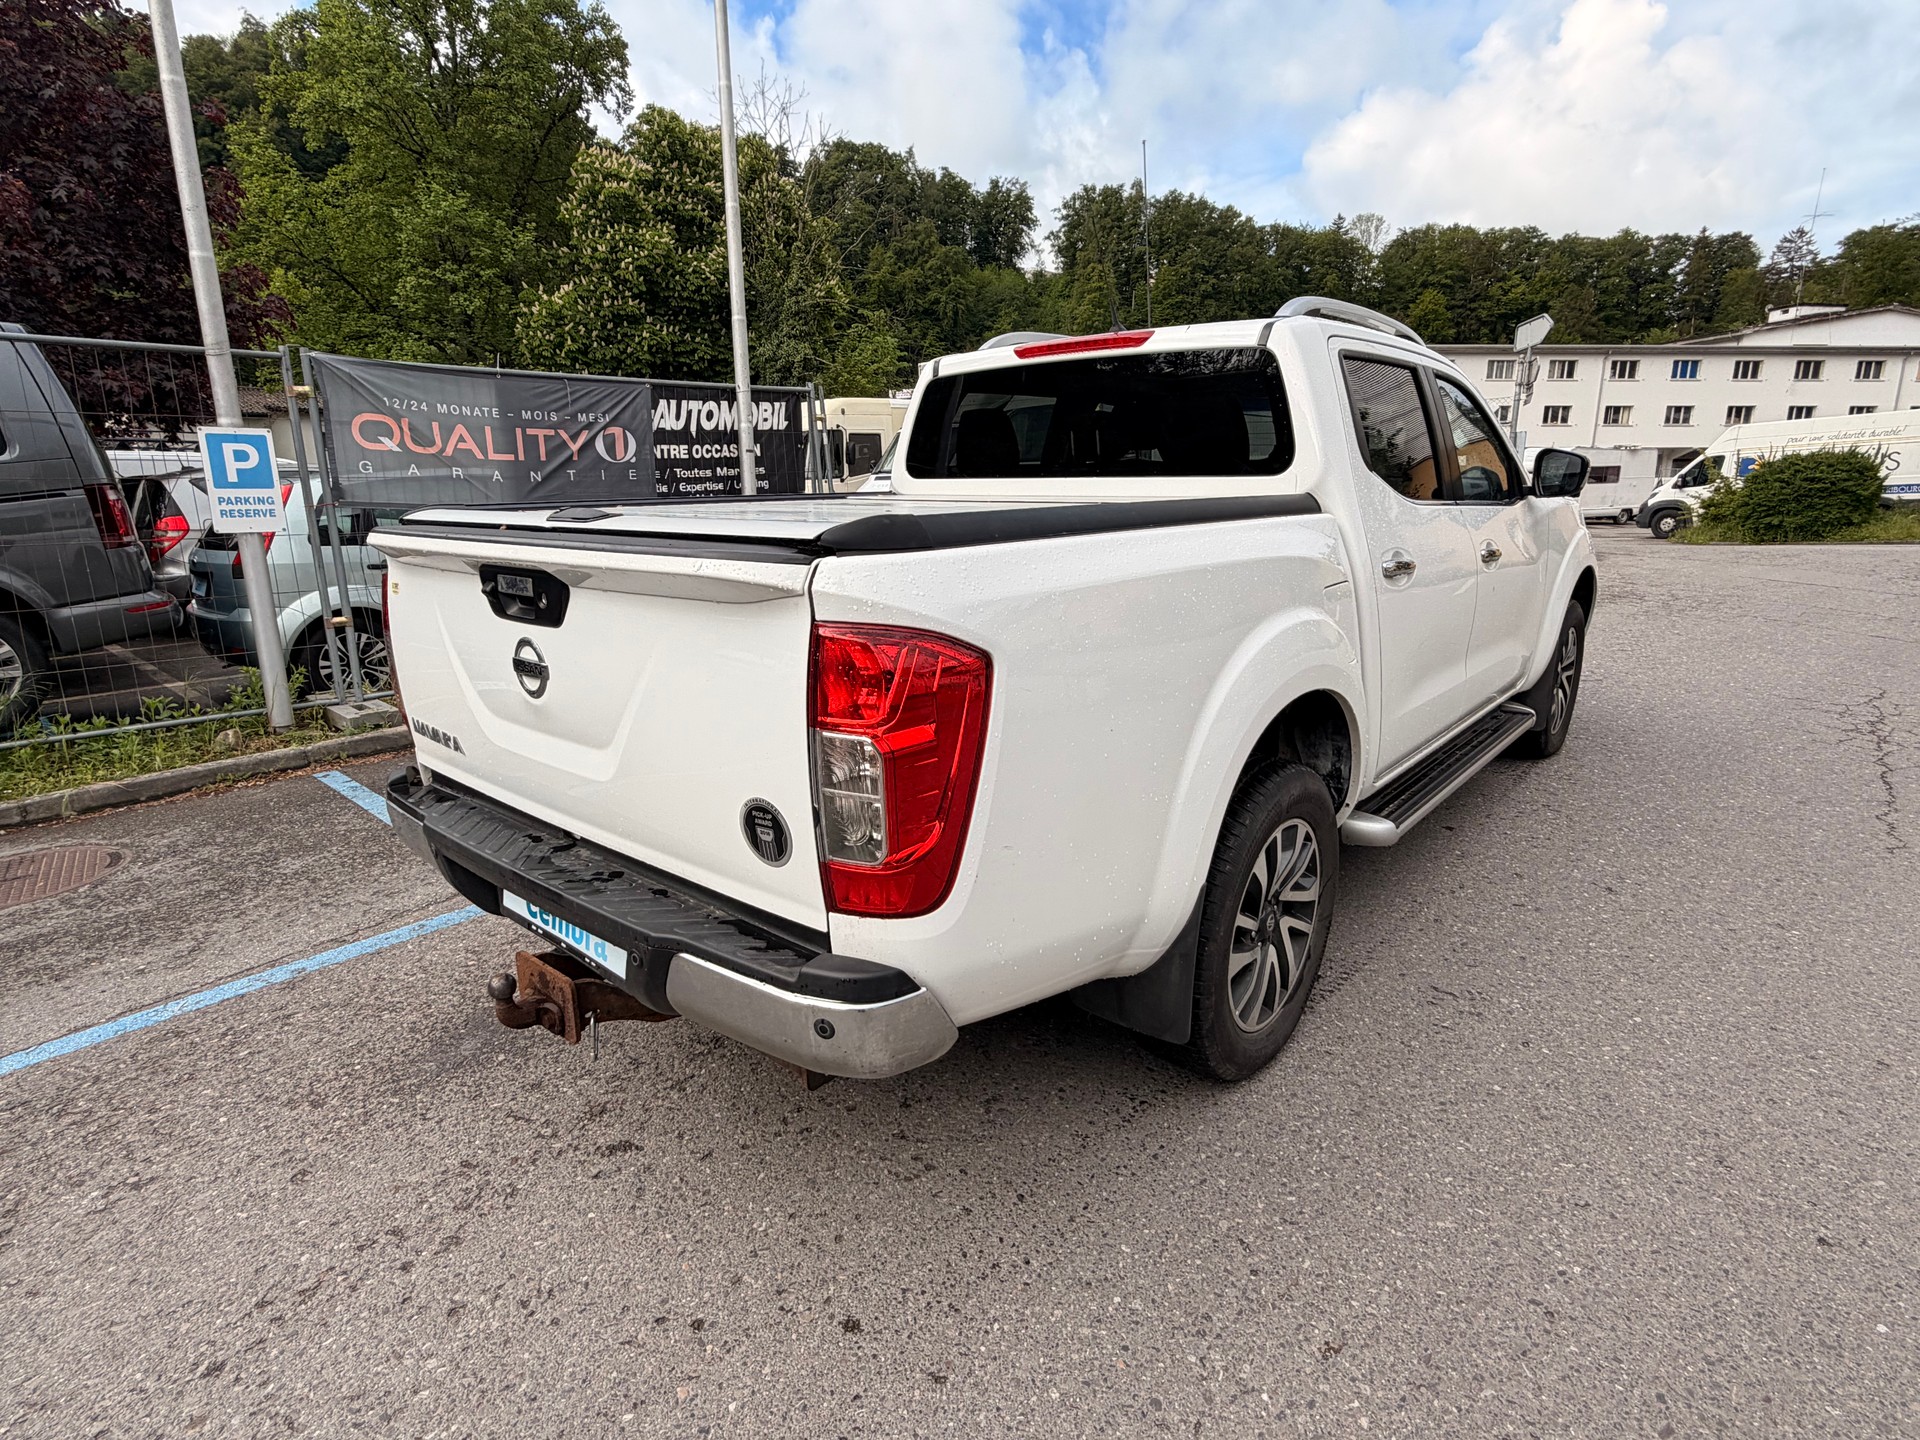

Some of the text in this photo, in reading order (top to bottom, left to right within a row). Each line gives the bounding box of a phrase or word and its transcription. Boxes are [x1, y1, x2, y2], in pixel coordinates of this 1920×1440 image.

[383, 397, 428, 412] 12/24
[437, 403, 500, 418] MONATE
[522, 410, 558, 421] MOIS
[578, 413, 609, 422] MESI
[351, 412, 590, 462] QUALITY
[654, 443, 761, 459] NTRE OCCASN
[222, 442, 260, 483] P
[358, 460, 637, 483] GARANTIE
[673, 467, 712, 478] Toutes
[716, 466, 765, 477] Mares
[679, 481, 724, 493] Expertise
[217, 496, 276, 506] PARKING
[220, 508, 277, 519] RESERVE
[514, 660, 545, 677] SSAN
